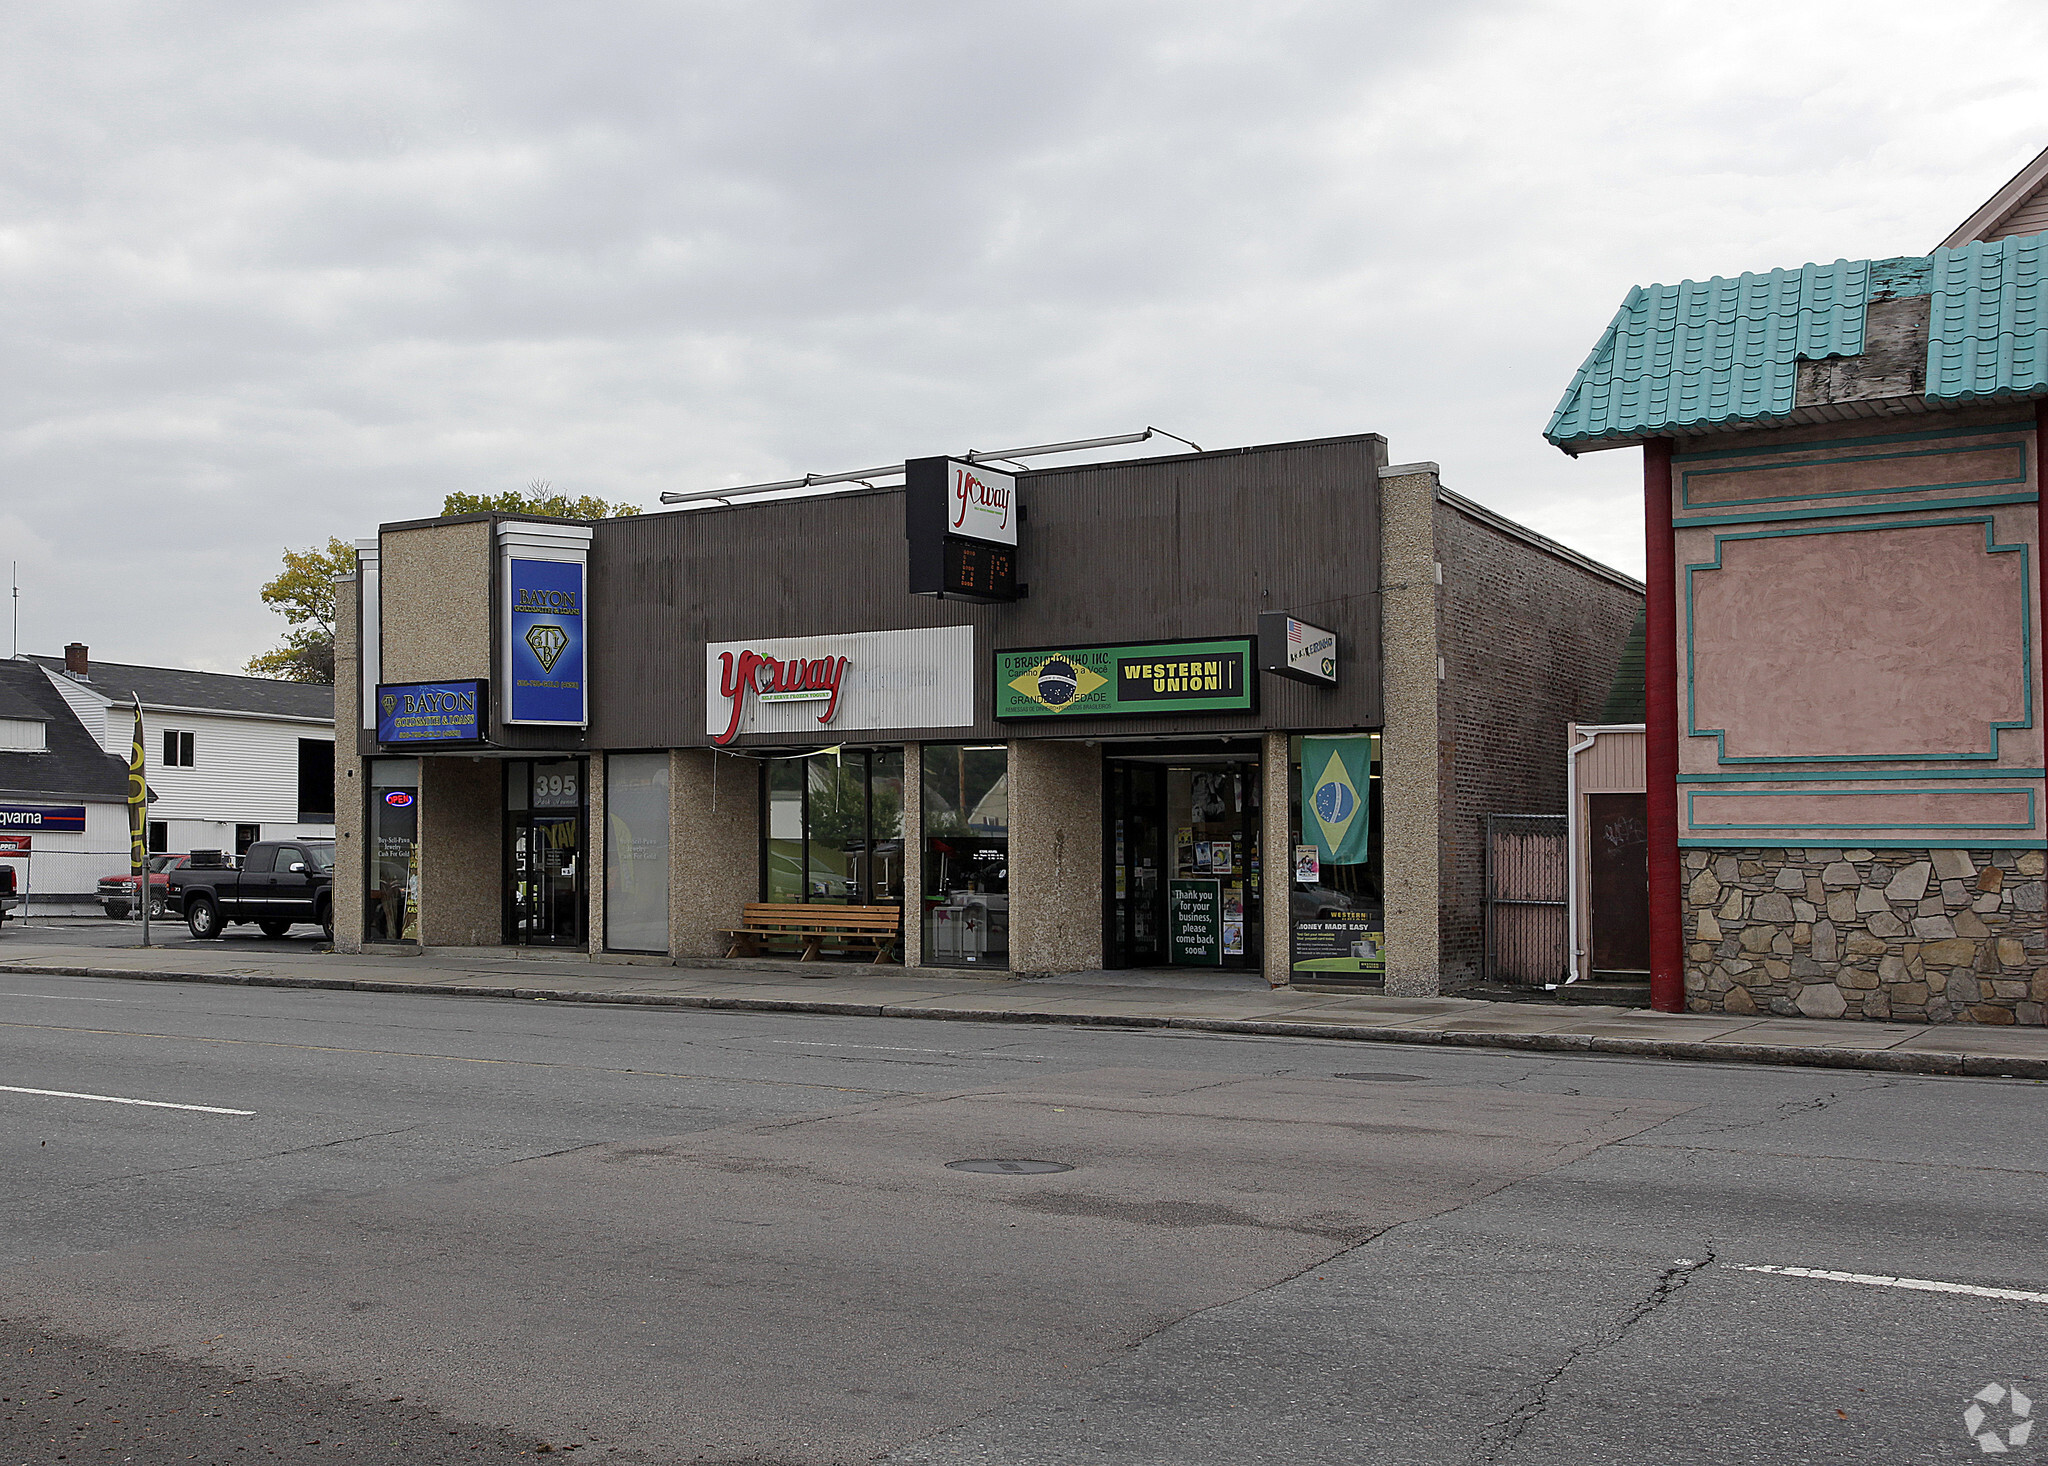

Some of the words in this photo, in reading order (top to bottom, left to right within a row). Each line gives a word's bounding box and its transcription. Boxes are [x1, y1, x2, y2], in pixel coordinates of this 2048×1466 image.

[519, 588, 576, 607] BAYON
[514, 604, 552, 614] GOLDSMITH
[1004, 657, 1011, 669] O
[1092, 652, 1112, 665] INC.
[1008, 668, 1038, 678] Carinho
[1088, 665, 1108, 674] Você
[1124, 661, 1218, 680] WESTERN
[1153, 676, 1218, 693] UNION
[403, 691, 476, 714] BAYON
[394, 716, 441, 728] GOLDSMITH
[441, 715, 449, 726] &
[449, 714, 475, 725] LOANS
[536, 775, 577, 797] 395
[387, 794, 409, 805] OPEN
[384, 844, 401, 852] Jewelry
[1175, 889, 1198, 900] Thank
[1199, 892, 1213, 902] you
[1180, 900, 1191, 911] for
[1193, 903, 1210, 912] your
[1179, 911, 1212, 923] business,
[1182, 923, 1207, 935] please
[1324, 923, 1347, 931] MADE
[1175, 935, 1196, 943] come
[1196, 934, 1215, 944] back
[1185, 945, 1206, 955] soon!
